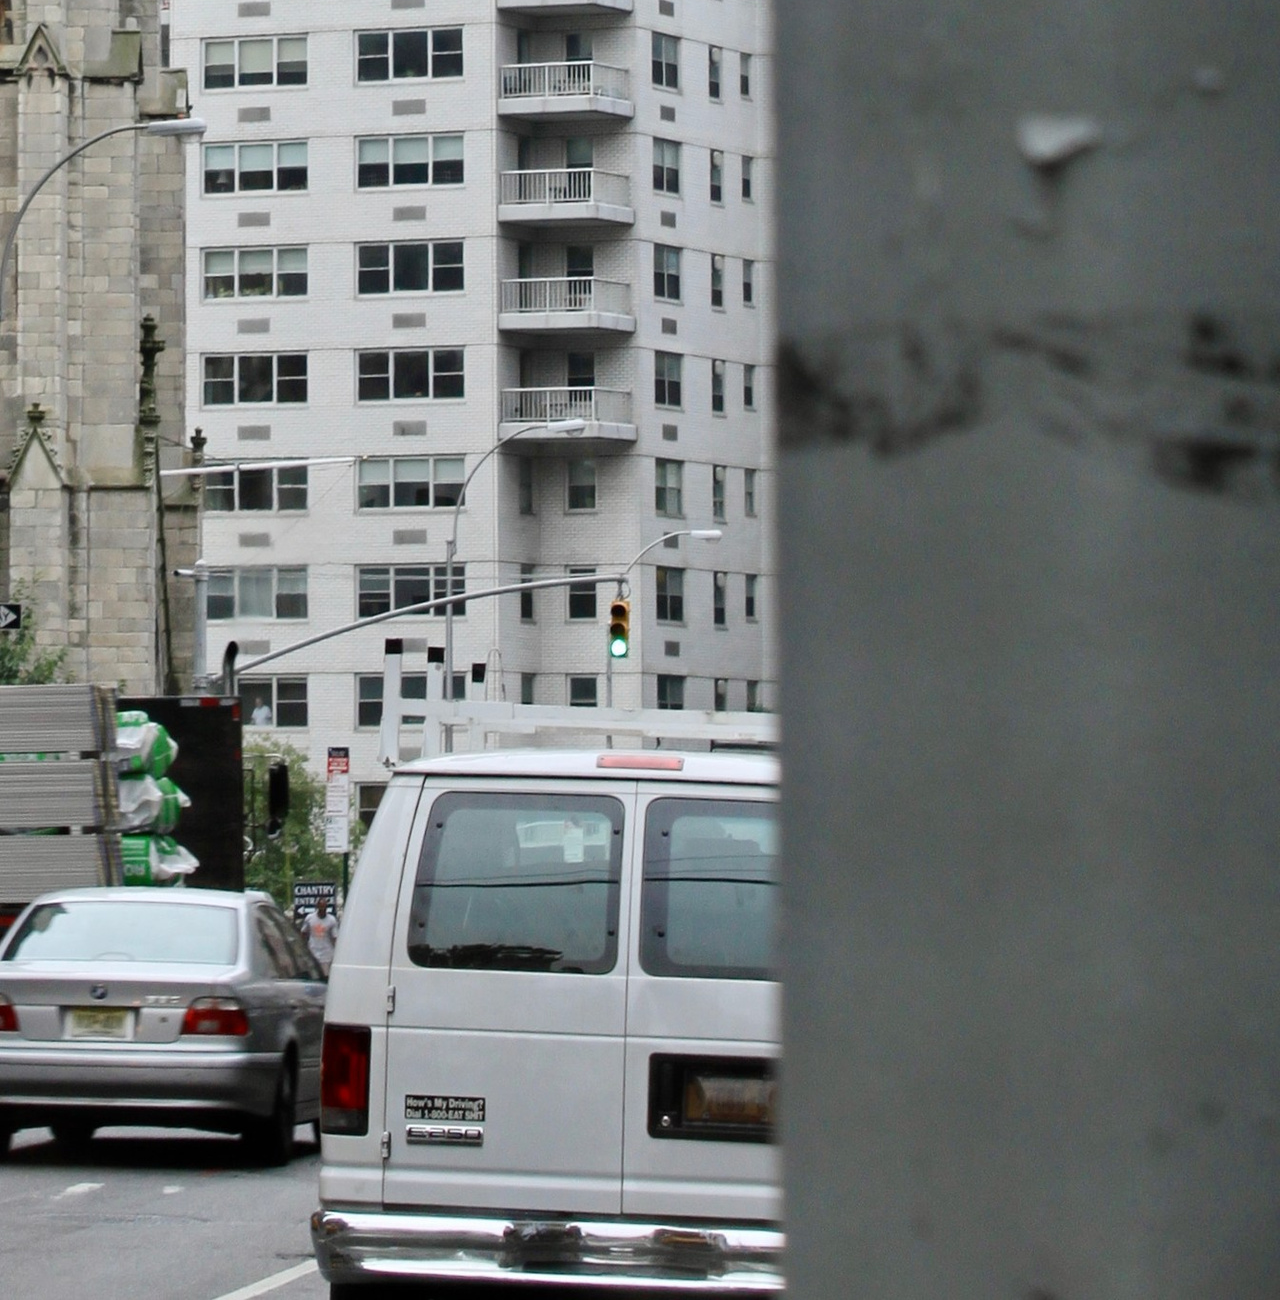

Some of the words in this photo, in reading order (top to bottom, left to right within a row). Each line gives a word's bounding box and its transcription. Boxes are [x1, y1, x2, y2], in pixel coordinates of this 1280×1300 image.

[294, 885, 335, 896] CHANTRY
[295, 896, 335, 906] ENTRACE
[406, 1097, 432, 1107] How's
[434, 1098, 447, 1109] My
[448, 1099, 484, 1111] Driving?
[406, 1109, 422, 1118] Dial
[424, 1110, 463, 1120] 1-800-EAT
[464, 1110, 484, 1120] SHIT
